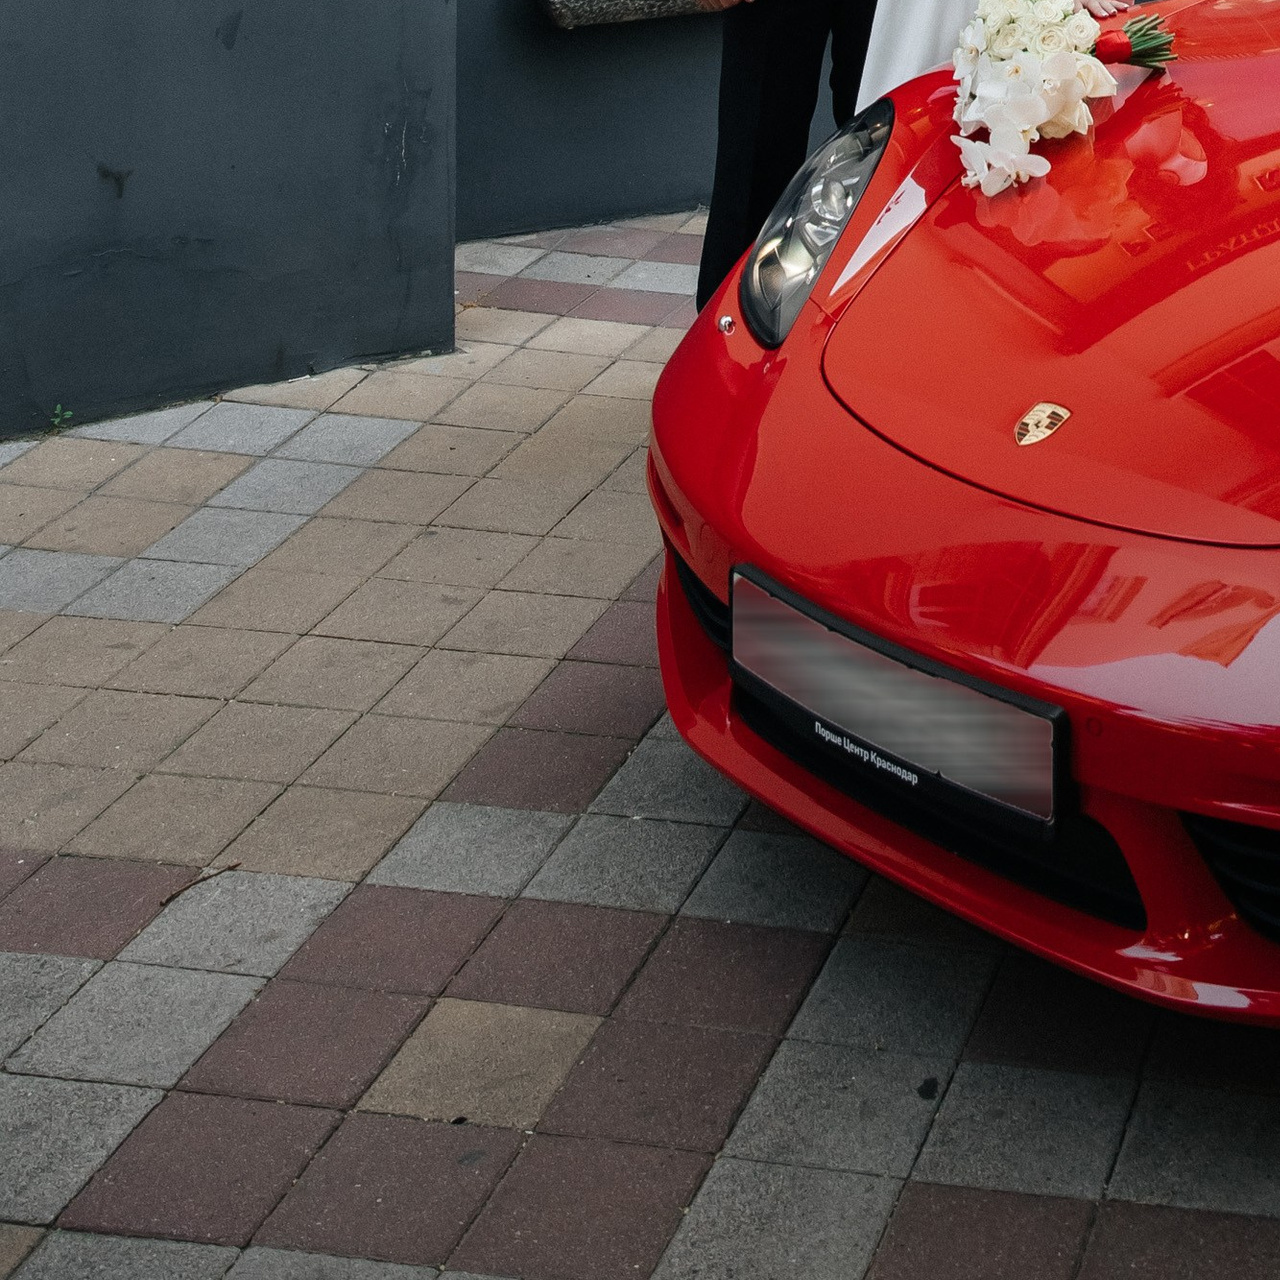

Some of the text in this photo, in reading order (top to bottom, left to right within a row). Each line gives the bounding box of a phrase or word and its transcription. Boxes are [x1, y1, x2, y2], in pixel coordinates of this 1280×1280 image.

[815, 721, 918, 786] Порше Центр Краснодар
